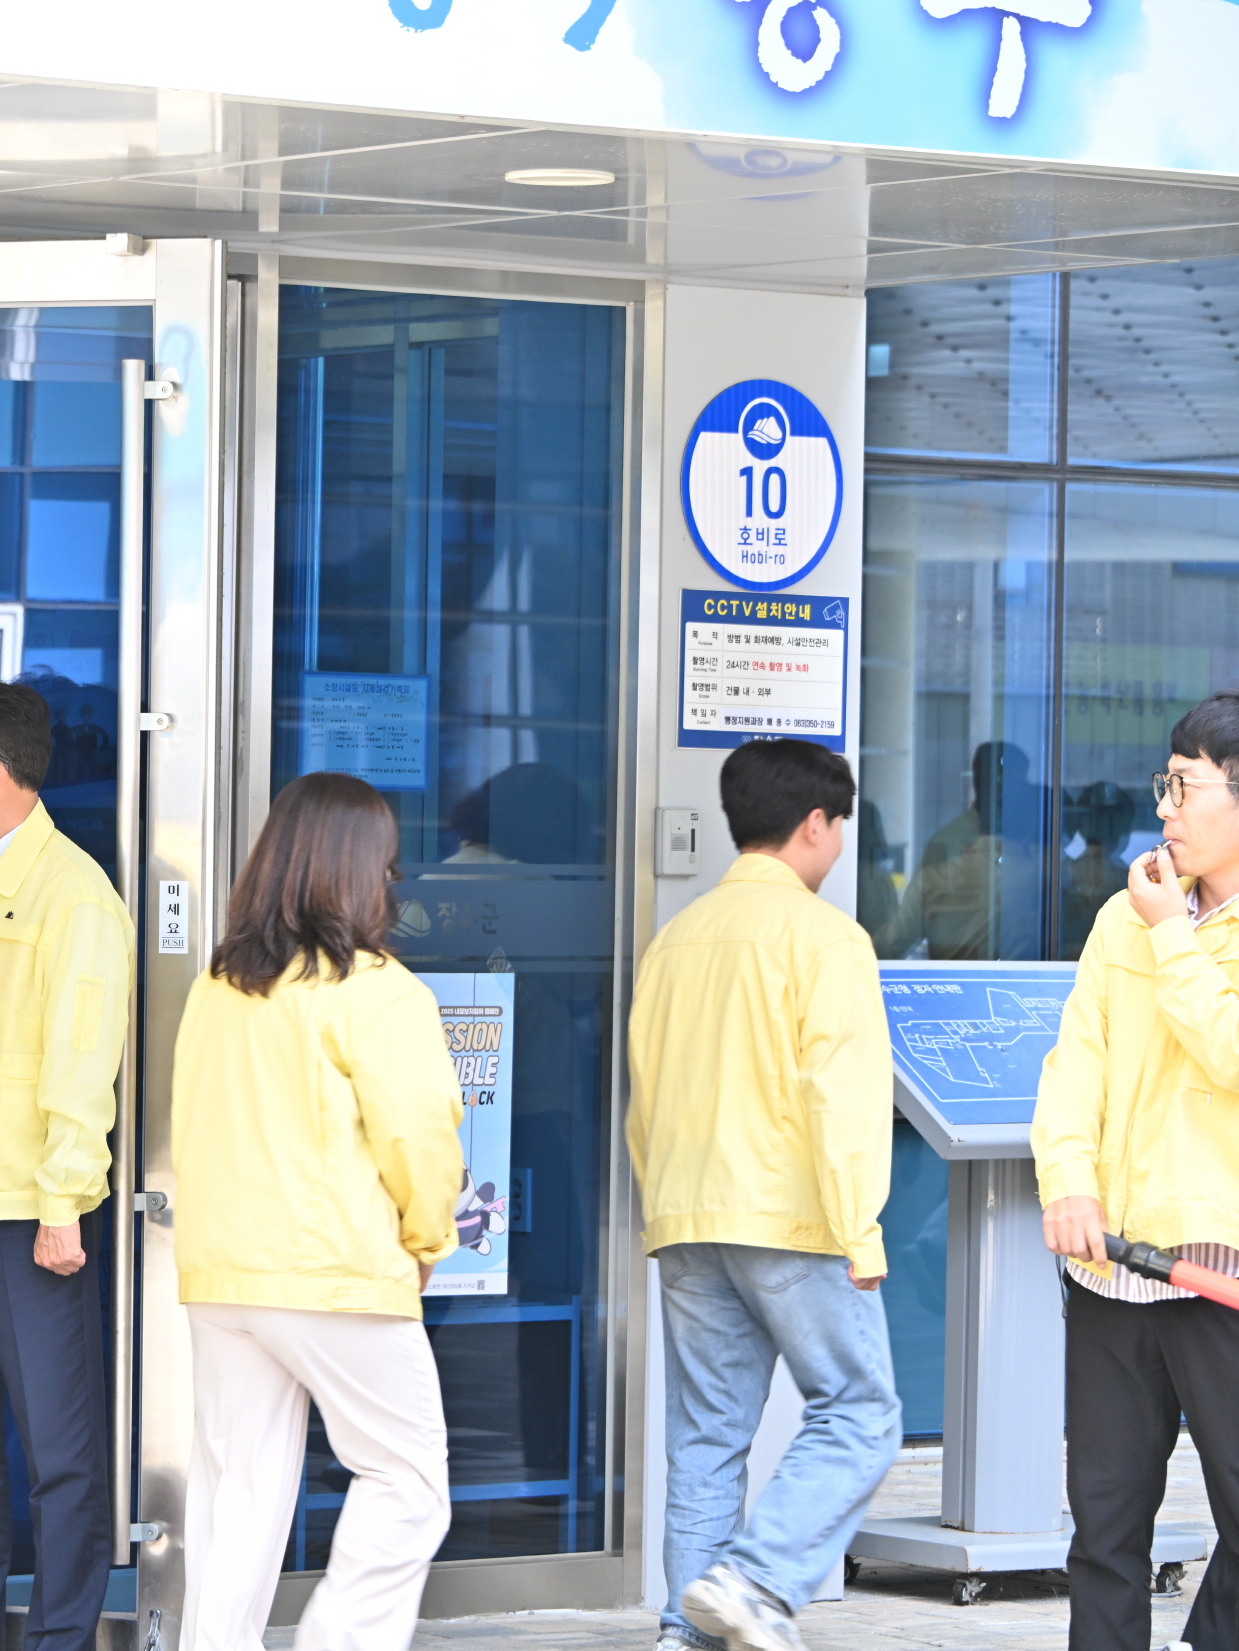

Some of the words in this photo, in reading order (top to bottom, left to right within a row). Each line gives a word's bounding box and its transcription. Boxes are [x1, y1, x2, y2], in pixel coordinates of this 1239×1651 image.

[738, 465, 788, 520] 10
[737, 526, 788, 547] 호비로
[741, 549, 786, 566] Hobi-ro
[703, 598, 812, 621] CCTV설치안내
[726, 633, 742, 644] 방범
[743, 634, 752, 645] 및
[786, 636, 829, 648] 시설안전관리
[691, 655, 719, 667] 촬영시간
[725, 659, 750, 671] 24시간
[751, 660, 766, 672] 연속
[768, 661, 783, 673] 촬영
[785, 662, 793, 673] 및
[794, 662, 810, 673] 녹화
[691, 682, 718, 693] 촬영범위
[725, 686, 741, 697] 건물
[166, 883, 180, 934] 미세요
[162, 938, 185, 947] PUSH
[440, 1007, 454, 1015] 2025
[451, 1055, 500, 1087] IBLE
